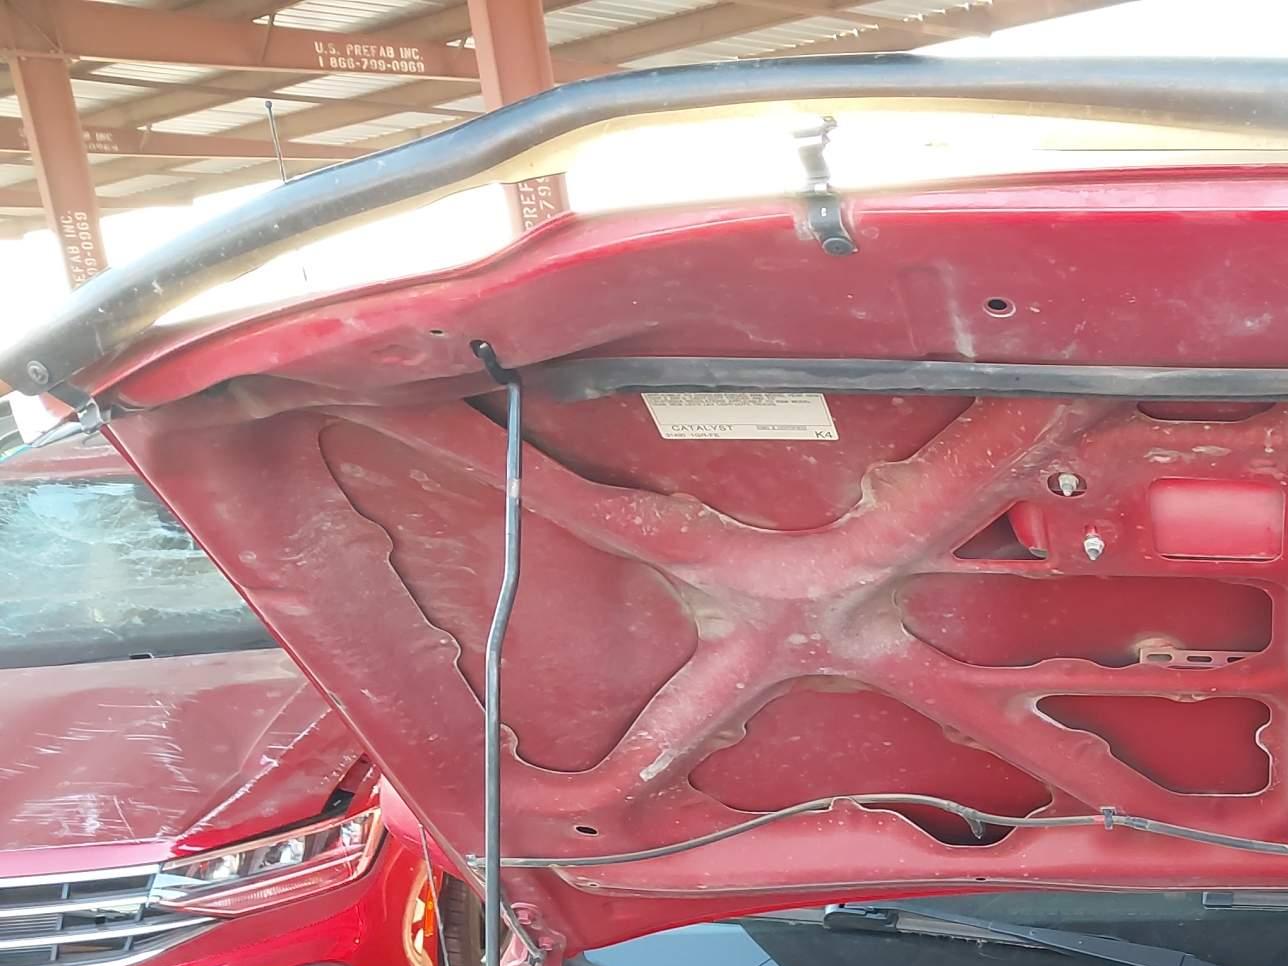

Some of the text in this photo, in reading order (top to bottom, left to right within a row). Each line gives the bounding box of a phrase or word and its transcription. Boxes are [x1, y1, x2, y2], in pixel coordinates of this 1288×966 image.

[313, 40, 424, 61] U.S. PREFAB INC.
[317, 55, 324, 68] 1
[671, 424, 734, 432] CATALYST
[814, 430, 834, 439] K4
